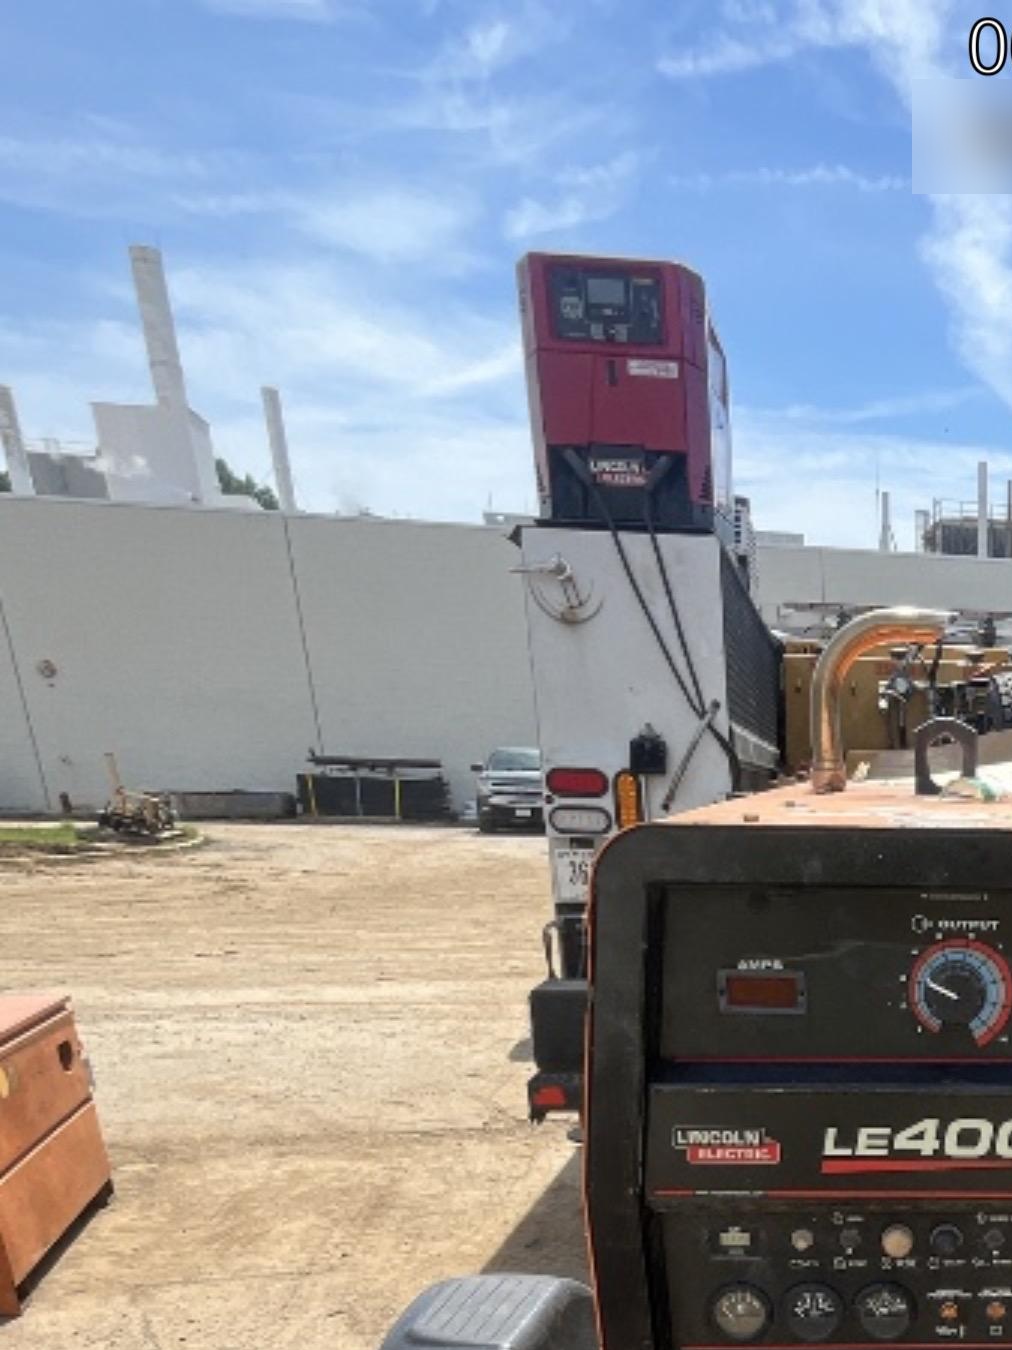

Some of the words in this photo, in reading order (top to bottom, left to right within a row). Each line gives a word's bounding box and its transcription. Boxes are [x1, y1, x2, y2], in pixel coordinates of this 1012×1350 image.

[937, 919, 1000, 931] OUTPUT
[737, 958, 785, 970] AMPS
[677, 1129, 761, 1145] LINCOLN
[697, 1147, 772, 1160] ELECTRIC
